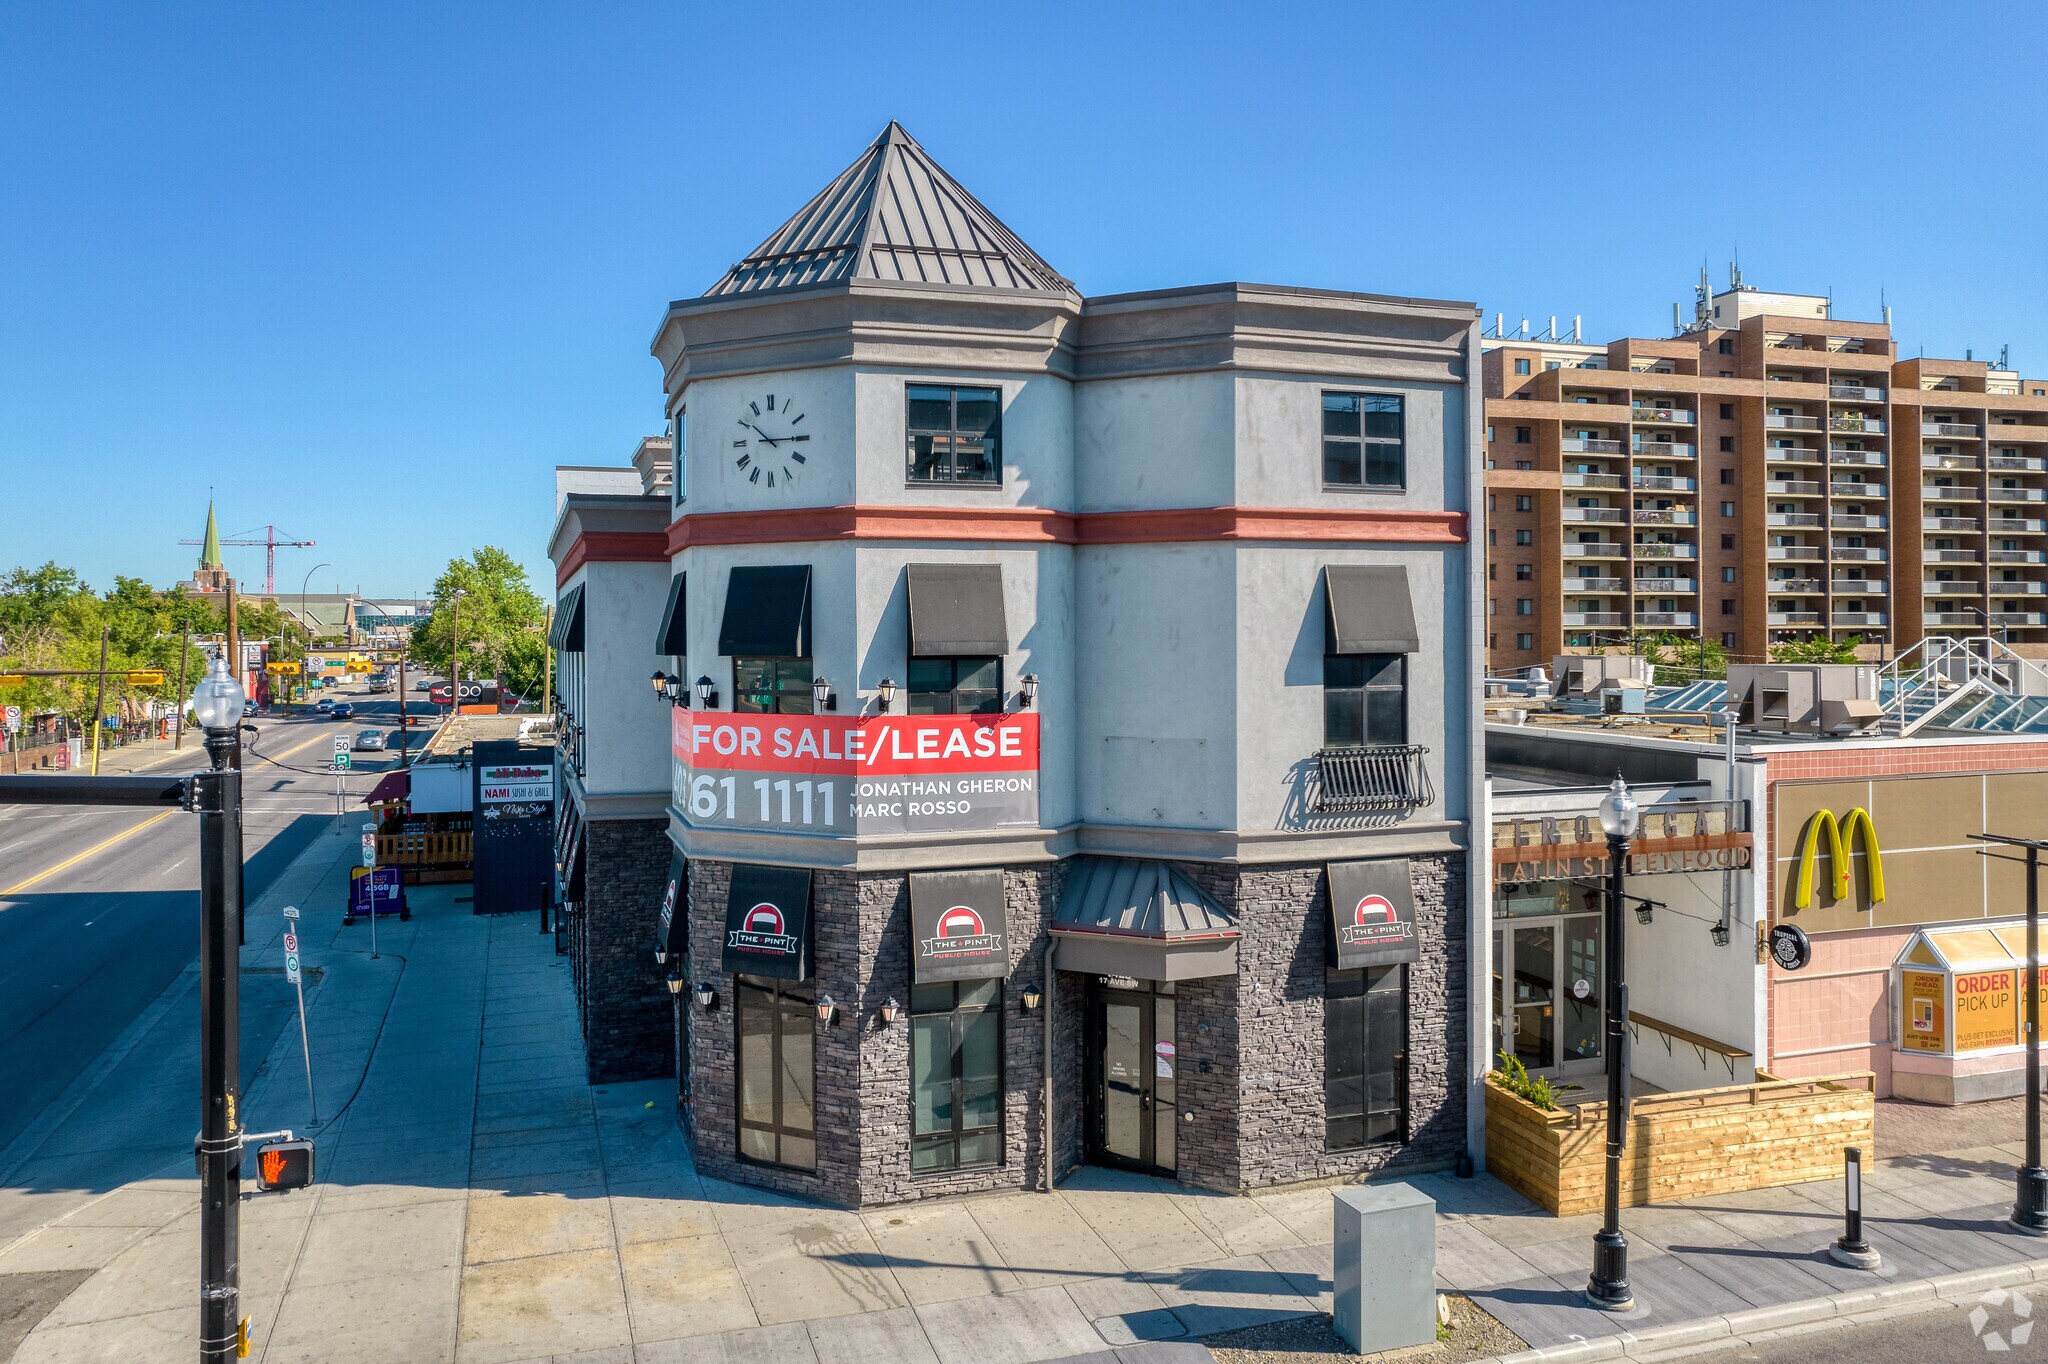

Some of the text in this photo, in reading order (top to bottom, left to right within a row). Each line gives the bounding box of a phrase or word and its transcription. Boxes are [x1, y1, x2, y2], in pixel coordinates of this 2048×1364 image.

[443, 682, 482, 697] cbo
[336, 741, 349, 751] 50
[692, 724, 762, 757] FOR
[773, 725, 1022, 766] SALE/LEASE
[493, 766, 542, 779] Ali Baba
[484, 786, 550, 799] NAMI SUSHI & GRILL
[850, 777, 1032, 798] JONATHAN GHERON
[526, 802, 547, 815] Style
[753, 778, 834, 826] 1111
[850, 800, 971, 818] MARC ROSSO
[1511, 807, 1737, 846] TROICAL
[1497, 846, 1750, 881] LATIN STEET FOOD
[365, 884, 389, 892] 45GB
[1354, 925, 1402, 936] THE PINT
[1773, 929, 1798, 942] TROPICAL
[740, 935, 787, 946] THE PINT
[935, 938, 989, 949] THE PINT
[1380, 936, 1404, 944] HOUSE
[736, 945, 761, 953] PUBLIC
[1098, 976, 1108, 984] 17
[1109, 978, 1125, 986] AVE
[1126, 979, 1139, 988] SW
[1914, 981, 1940, 989] AHEAD,
[1916, 975, 1940, 983] ORDER
[1956, 973, 2010, 994] ORDER
[1957, 992, 2009, 1012] PICK UP
[2021, 988, 2048, 1005] AD
[1957, 1033, 1972, 1042] PLUS
[1972, 1032, 1984, 1040] GET
[1985, 1027, 2015, 1038] EXCLUSIVE
[1957, 1041, 1969, 1050] AND
[1970, 1040, 1985, 1048] EARN
